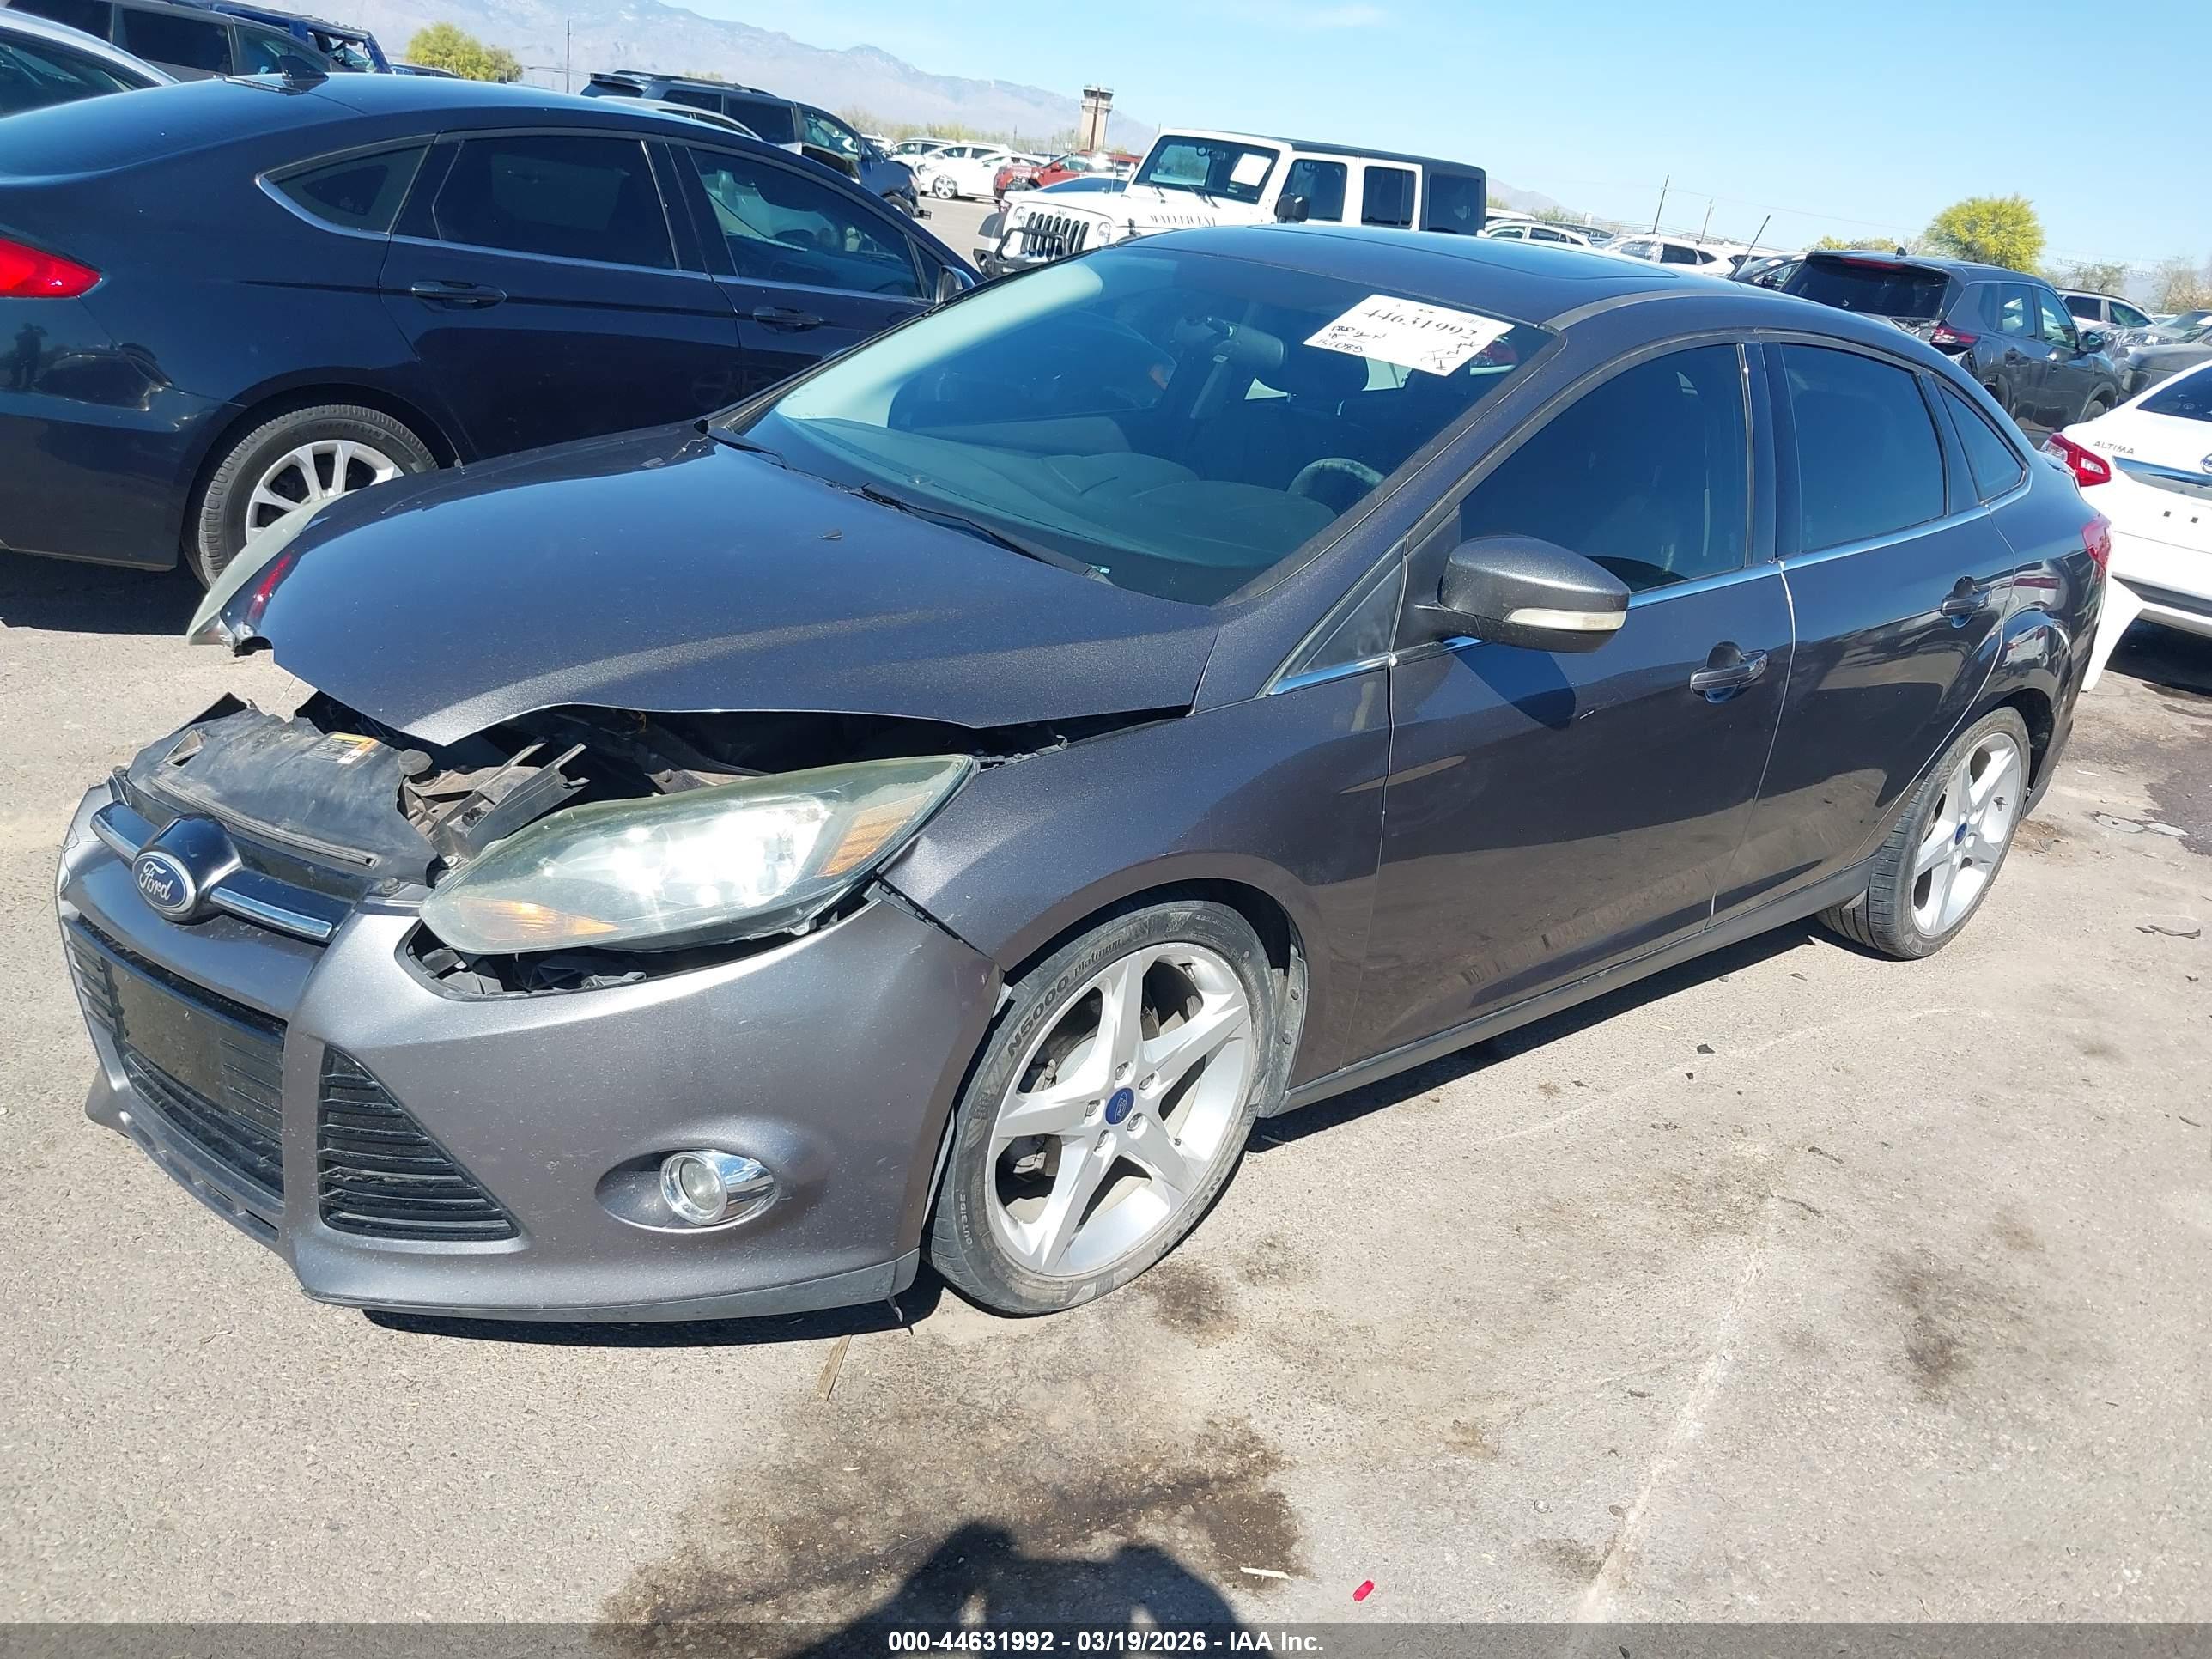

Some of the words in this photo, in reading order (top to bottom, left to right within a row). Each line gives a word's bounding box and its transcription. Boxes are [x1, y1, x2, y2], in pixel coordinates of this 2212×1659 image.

[2094, 441, 2135, 454] ALTIMA
[139, 860, 173, 901] Ford
[1007, 975, 1070, 1059] N5000
[1073, 939, 1121, 978] Platinum
[958, 1194, 973, 1245] OUTSIDE
